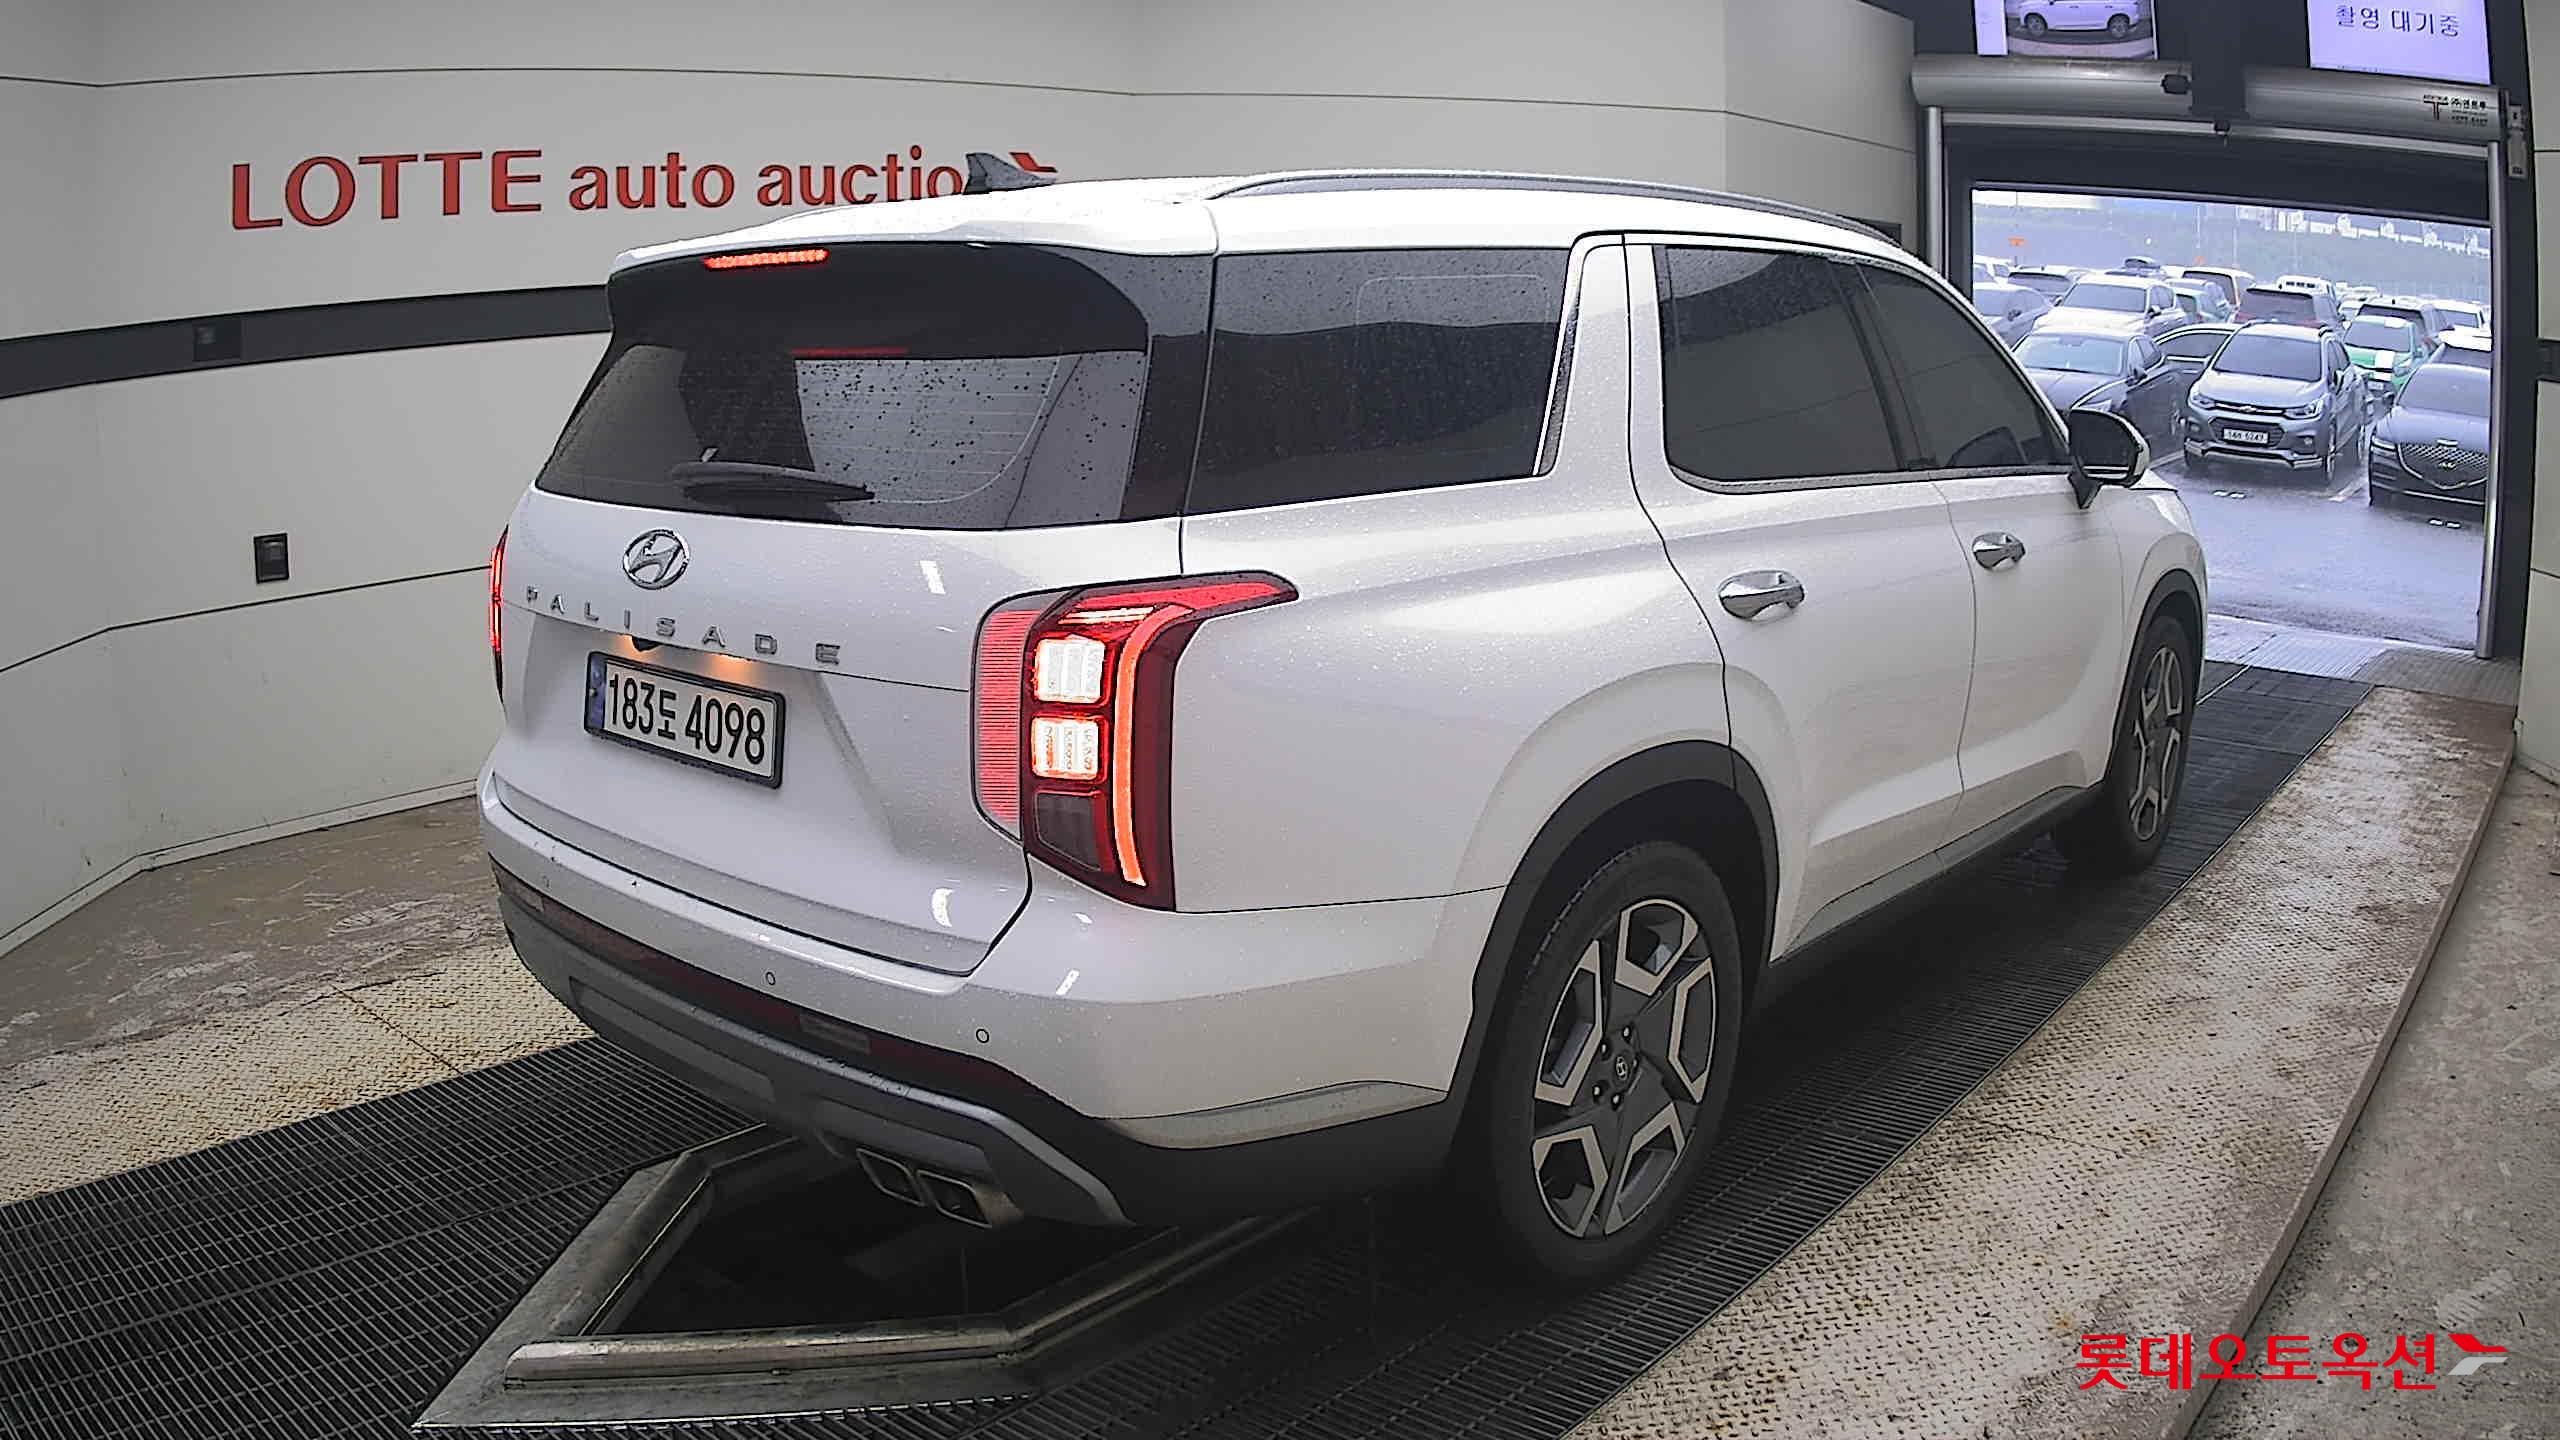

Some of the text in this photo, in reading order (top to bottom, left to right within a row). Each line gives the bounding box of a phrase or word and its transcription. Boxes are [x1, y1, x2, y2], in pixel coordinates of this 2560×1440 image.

[2336, 5, 2459, 37] 촬영 대기중
[231, 145, 964, 230] LOTTE auto auctio
[526, 585, 841, 665] PALISADE
[609, 672, 766, 765] 183도 4098
